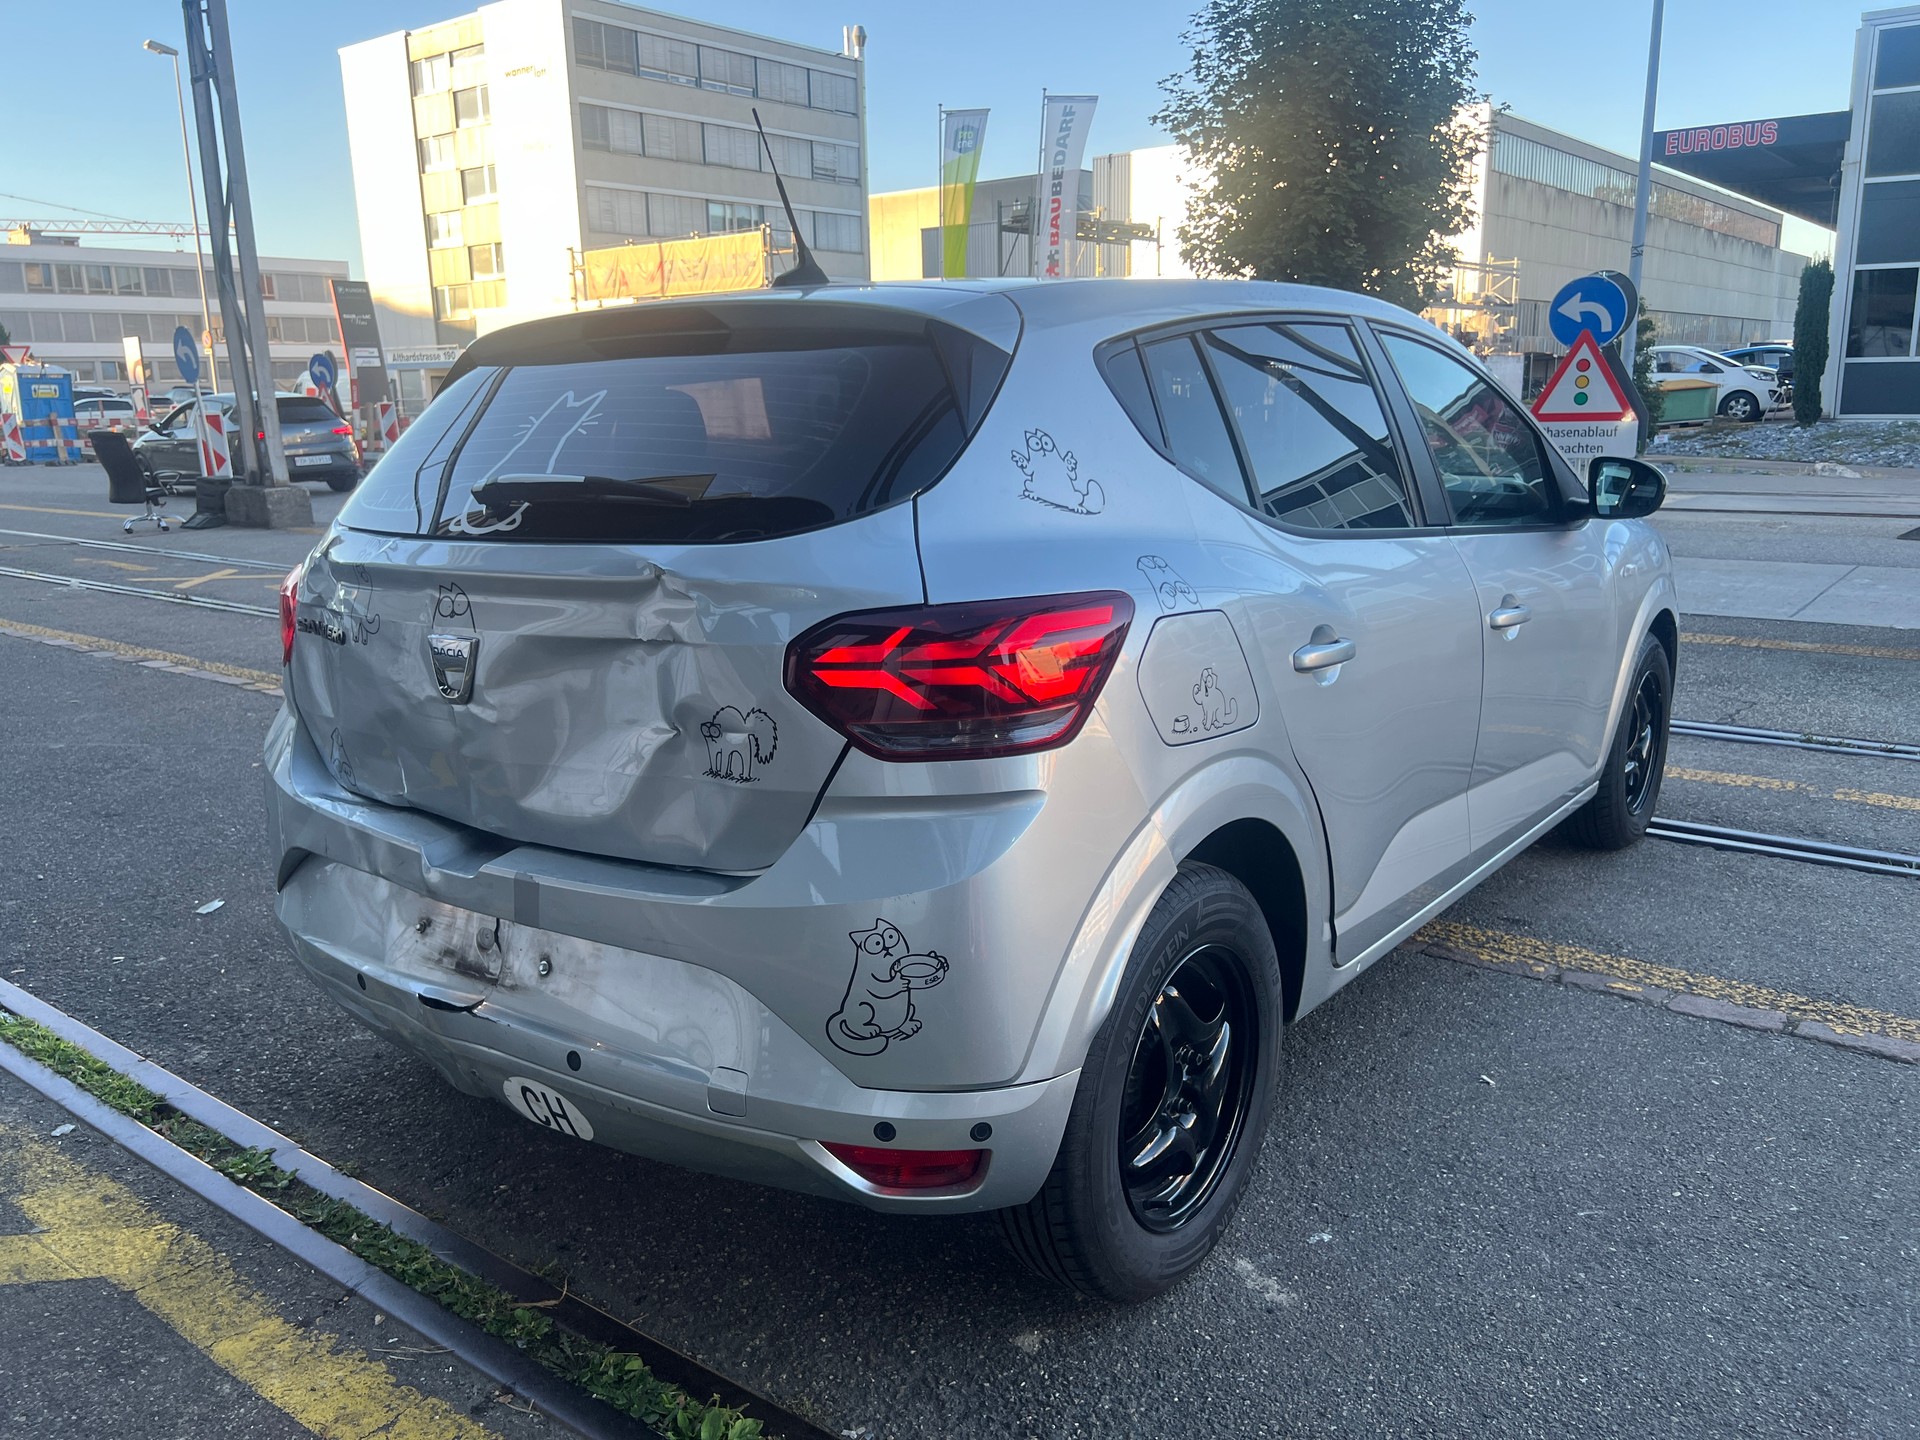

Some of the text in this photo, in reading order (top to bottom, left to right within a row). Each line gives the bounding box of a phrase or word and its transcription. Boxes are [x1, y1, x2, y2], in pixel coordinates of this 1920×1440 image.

[1665, 121, 1778, 155] EUROBUS
[1050, 105, 1076, 246] BAUBEDARF
[393, 351, 456, 362] Althardstrasse 190
[1558, 443, 1604, 454] eachten
[432, 647, 468, 660] DACIA
[521, 1086, 579, 1137] CH
